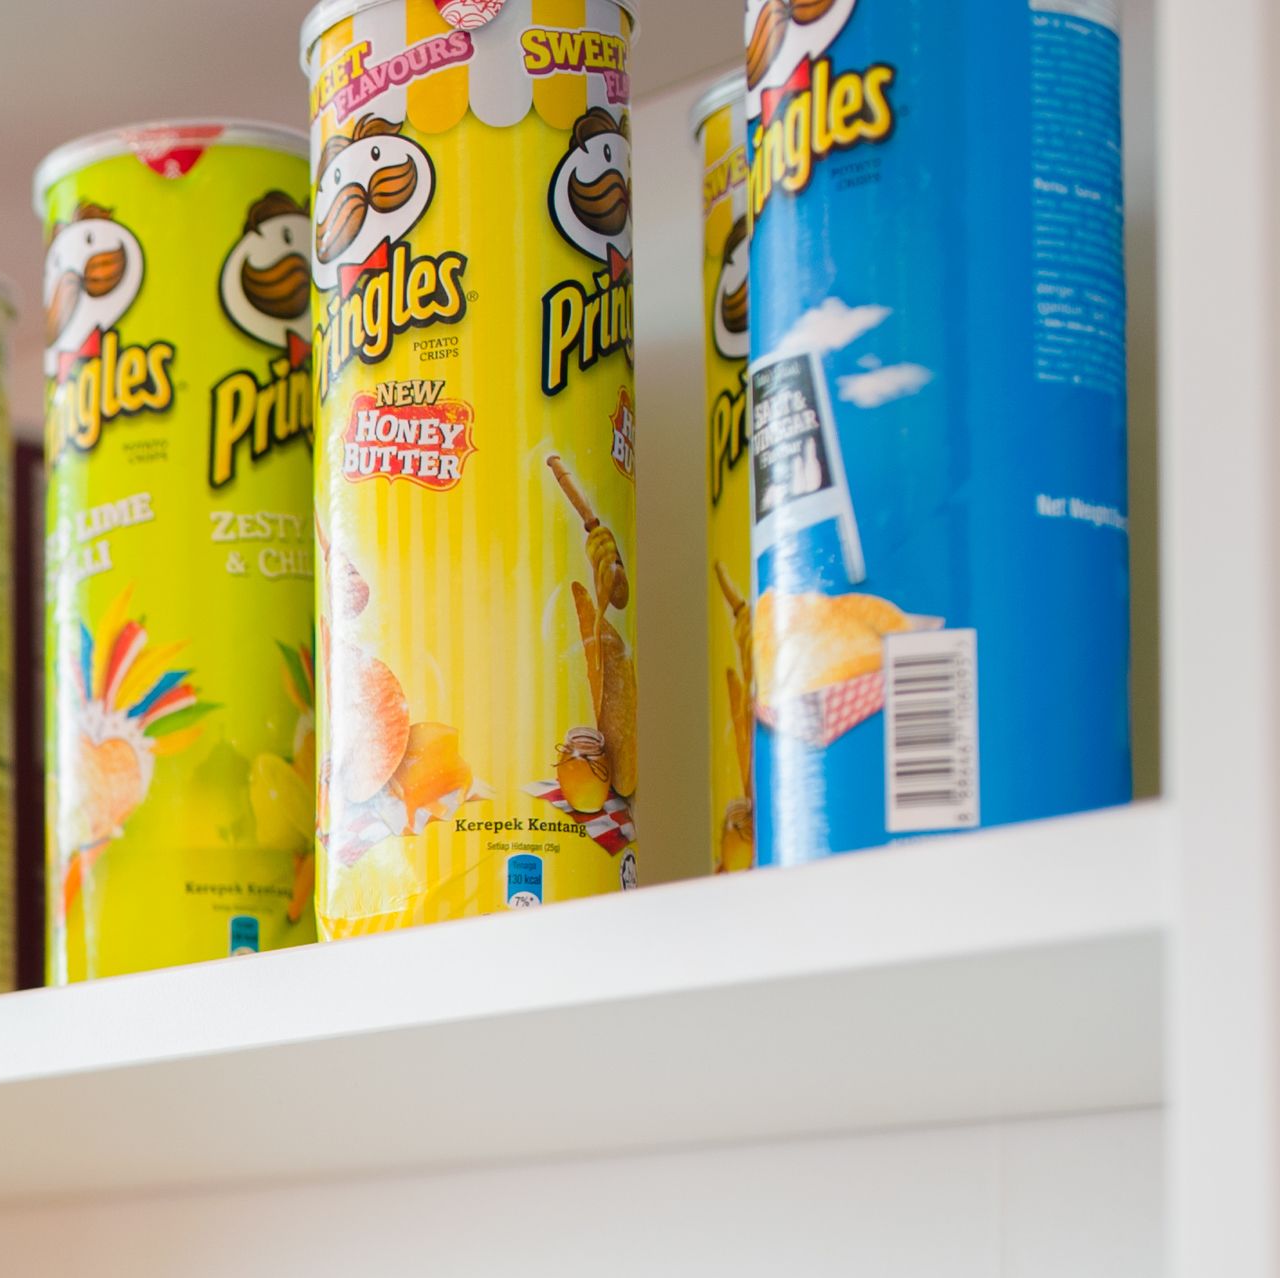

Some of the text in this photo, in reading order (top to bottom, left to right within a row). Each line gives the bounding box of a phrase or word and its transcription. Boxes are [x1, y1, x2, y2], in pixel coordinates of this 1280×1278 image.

[521, 29, 626, 72] SWEET
[333, 31, 474, 122] FLAVOURS
[413, 336, 459, 351] POTATO
[419, 348, 459, 361] CRISPS
[376, 380, 445, 407] NEW
[209, 357, 315, 488] Prin
[355, 409, 465, 450] HONEY
[342, 442, 461, 480] BUTTER
[76, 492, 154, 544] LIME
[210, 511, 303, 542] ZESTY
[455, 818, 587, 838] Kerepek Kentang
[487, 842, 510, 852] Setiap
[508, 874, 523, 885] 130
